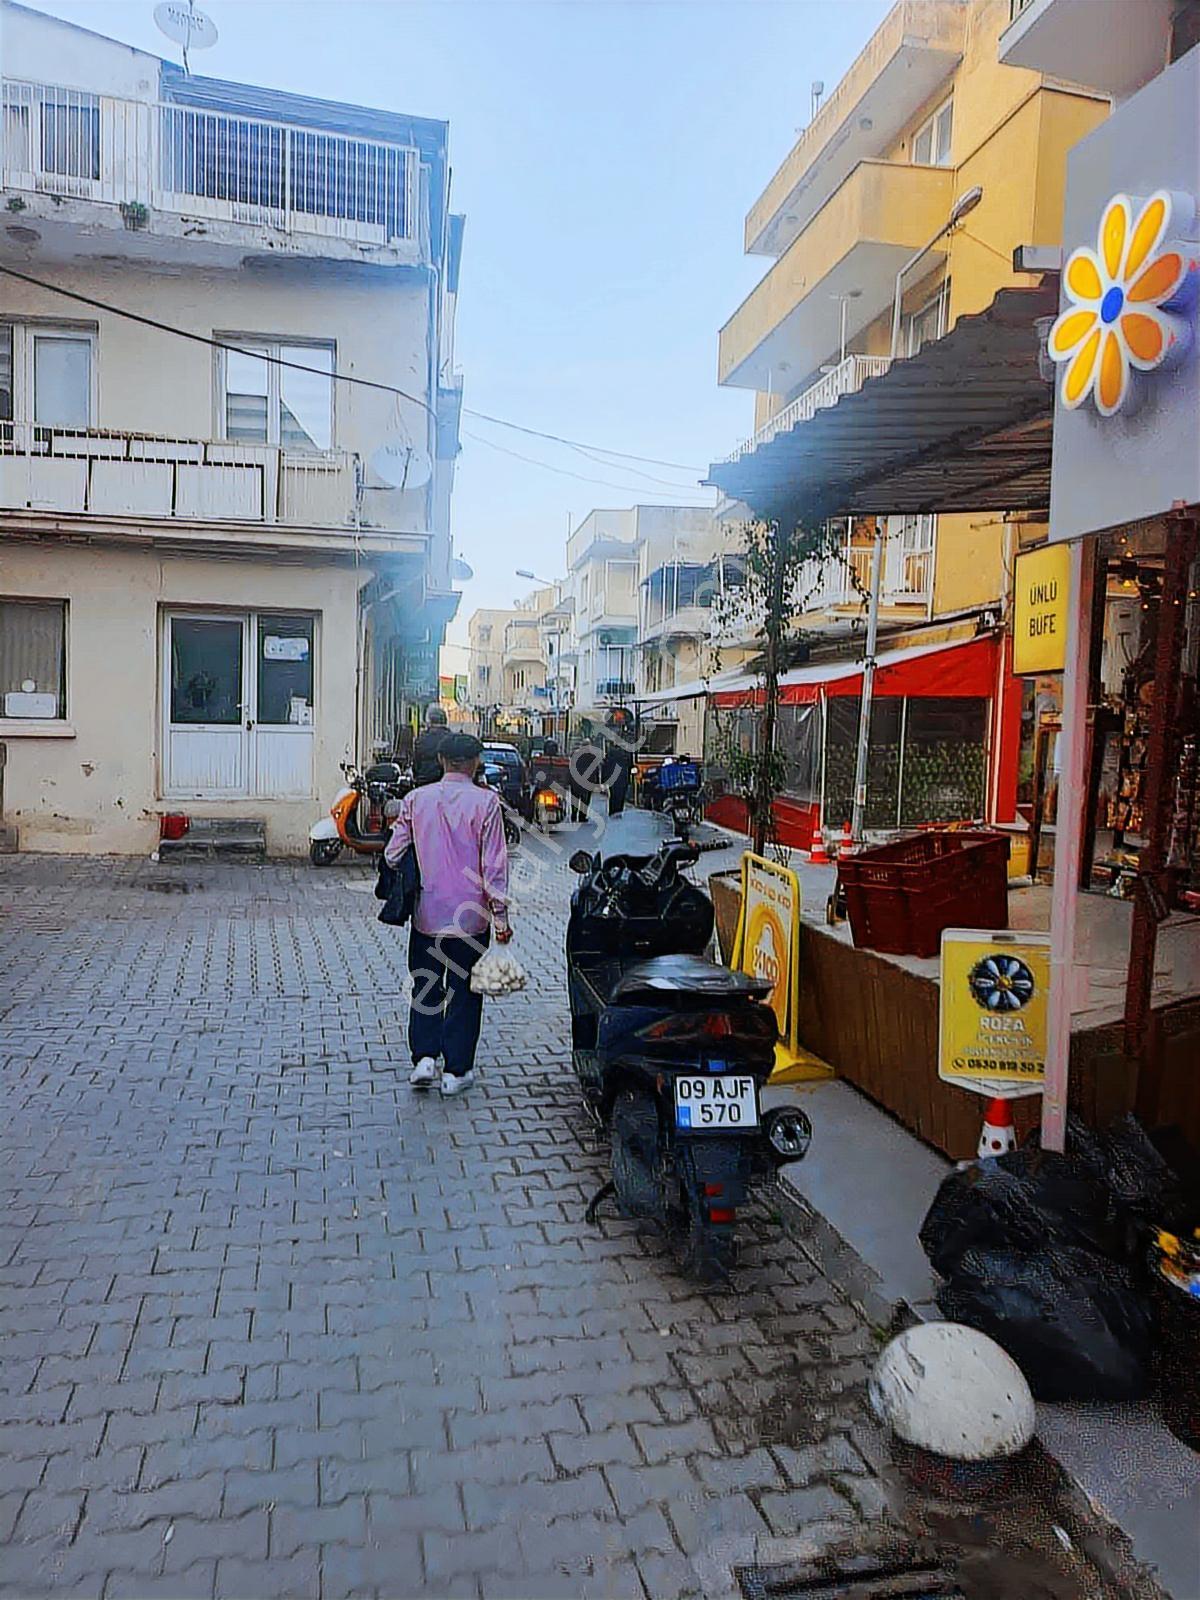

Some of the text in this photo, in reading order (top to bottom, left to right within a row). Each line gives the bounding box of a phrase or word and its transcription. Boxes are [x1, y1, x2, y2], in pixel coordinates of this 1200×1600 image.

[1029, 577, 1057, 606] ÜNLÜ
[1029, 611, 1056, 637] BÜFE
[679, 1079, 751, 1099] 09 AJF
[700, 1103, 741, 1123] 570
